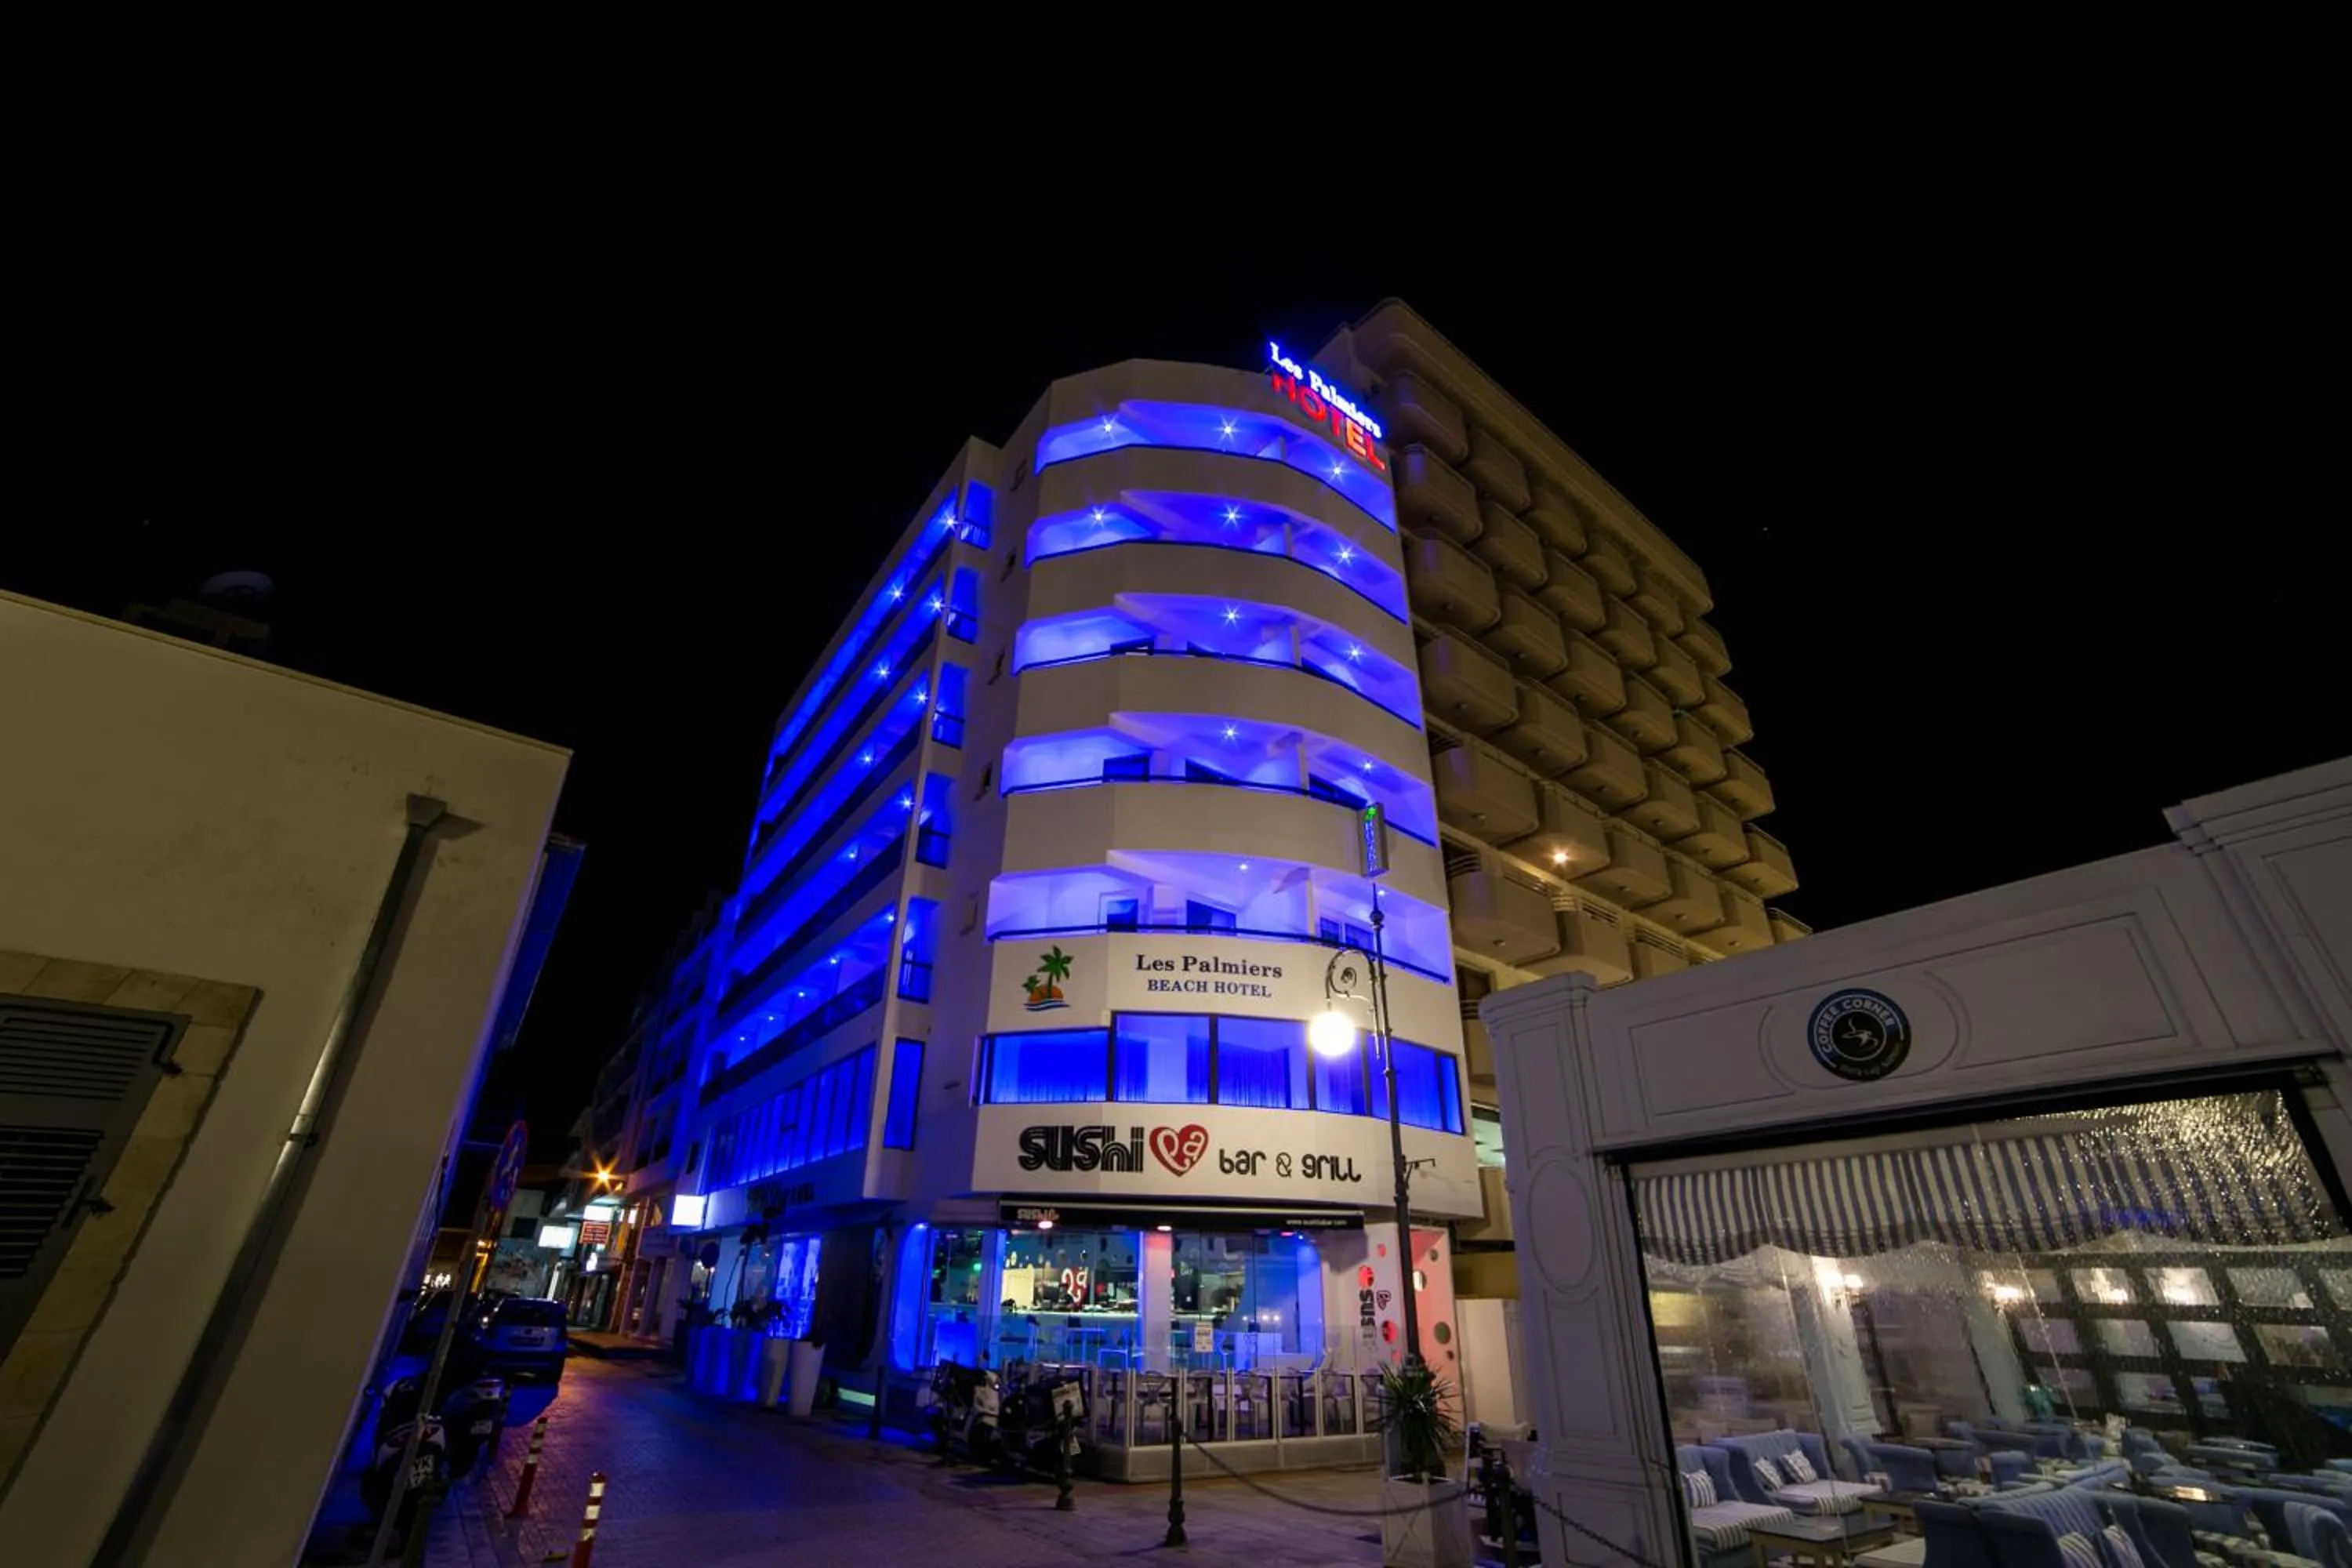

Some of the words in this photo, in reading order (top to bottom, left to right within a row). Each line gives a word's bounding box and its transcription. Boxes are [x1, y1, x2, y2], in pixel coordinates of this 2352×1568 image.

[1269, 341, 1303, 380] Les
[1308, 369, 1383, 439] Palmiers
[1271, 372, 1386, 471] HOTEL
[1136, 954, 1175, 971] Les
[1181, 956, 1283, 978] Palmiers
[1147, 978, 1208, 993] BEACH
[1214, 981, 1272, 998] HOTEL
[1842, 998, 1896, 1028] CORNER
[1219, 1149, 1267, 1176] bar
[1276, 1152, 1293, 1178] &
[1301, 1153, 1362, 1182] grill
